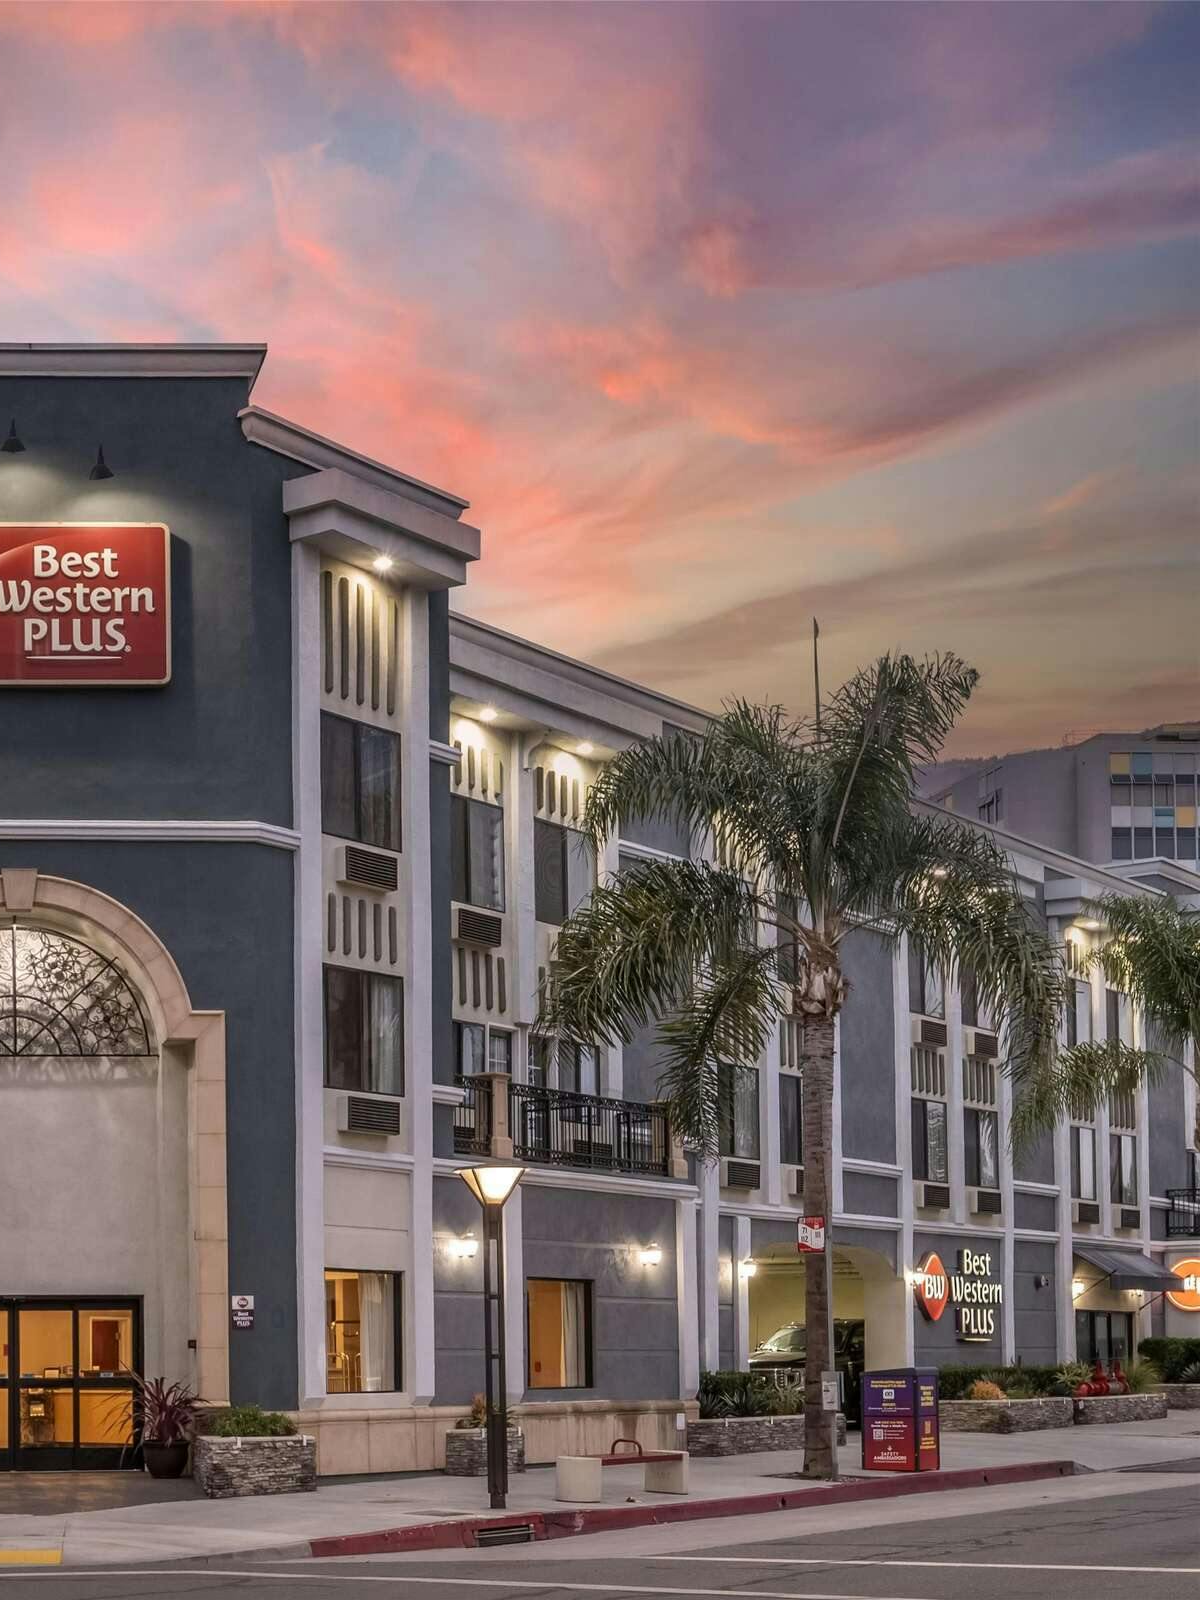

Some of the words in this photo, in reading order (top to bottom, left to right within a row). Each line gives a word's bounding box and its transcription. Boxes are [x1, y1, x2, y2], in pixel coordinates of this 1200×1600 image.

[32, 545, 119, 578] Best
[963, 1249, 991, 1276] Best
[925, 1274, 945, 1299] BW
[951, 1276, 1003, 1304] Western
[961, 1307, 995, 1334] PLUS
